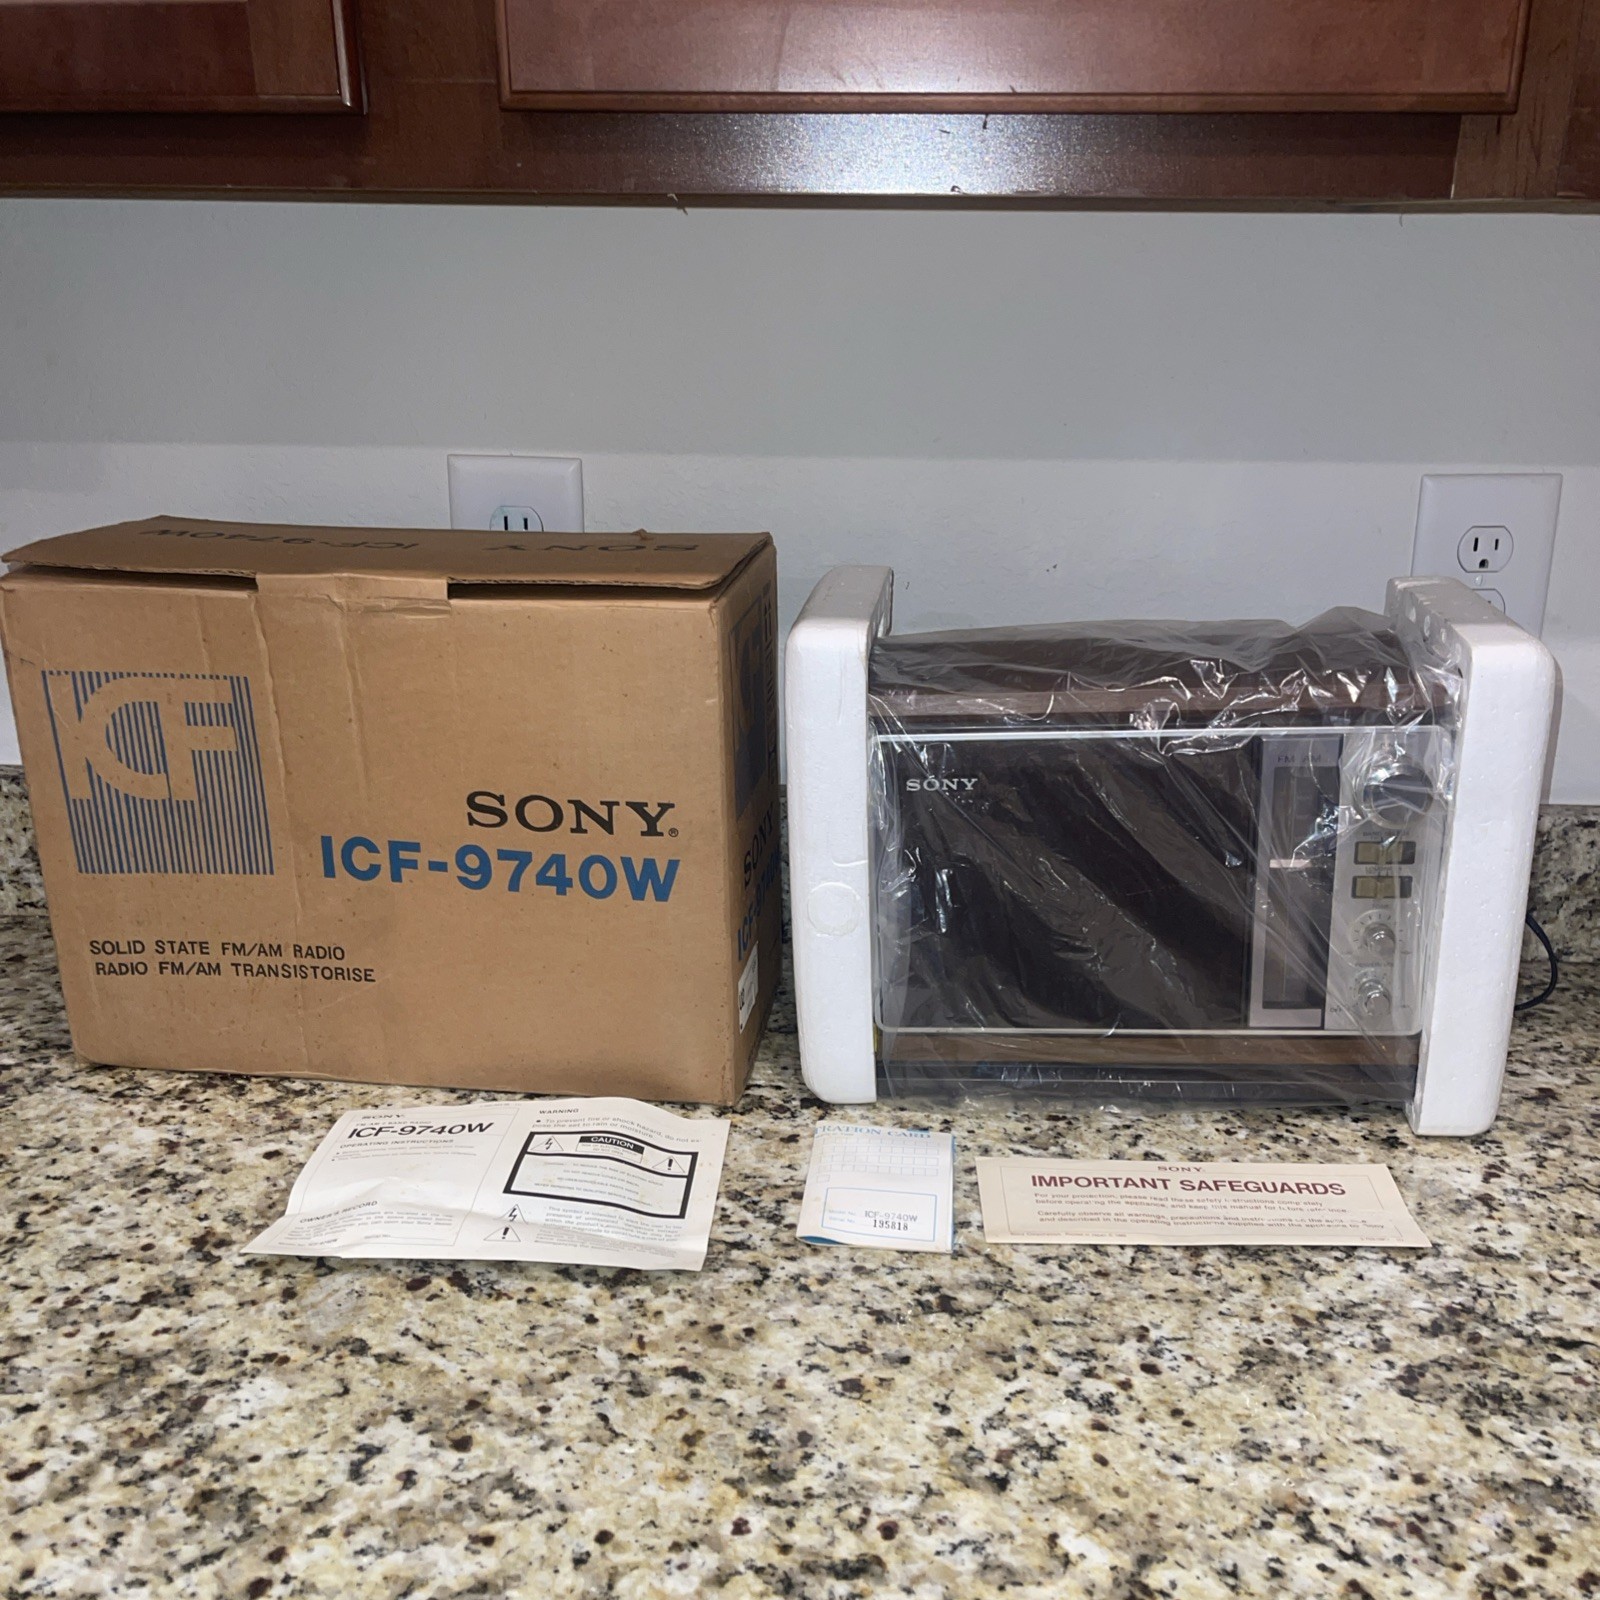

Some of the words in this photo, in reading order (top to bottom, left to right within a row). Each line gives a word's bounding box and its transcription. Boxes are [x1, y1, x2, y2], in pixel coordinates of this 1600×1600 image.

[482, 544, 699, 552] SONY
[906, 777, 978, 791] SONY
[466, 790, 677, 837] SONY
[320, 835, 681, 902] ICF-9740W
[89, 940, 145, 956] SOLID
[154, 940, 210, 956] STATE
[221, 942, 283, 958] FM/AM
[293, 945, 345, 960] RADIO
[95, 961, 148, 976] RADIO
[158, 961, 221, 976] FM/AM
[231, 963, 377, 983] TRANSISTORISE
[612, 1117, 635, 1126] shock
[347, 1122, 494, 1139] ICF-9740W
[339, 1141, 389, 1149] OPERATING
[590, 1136, 635, 1149] CAUTION
[1031, 1174, 1171, 1191] IMPORTANT
[1179, 1178, 1346, 1196] SAFEGUARDS
[1125, 1201, 1168, 1209] appliance,
[864, 1210, 918, 1222] ICF-9740W
[1130, 1218, 1171, 1226] operating
[872, 1219, 909, 1231] 195818
